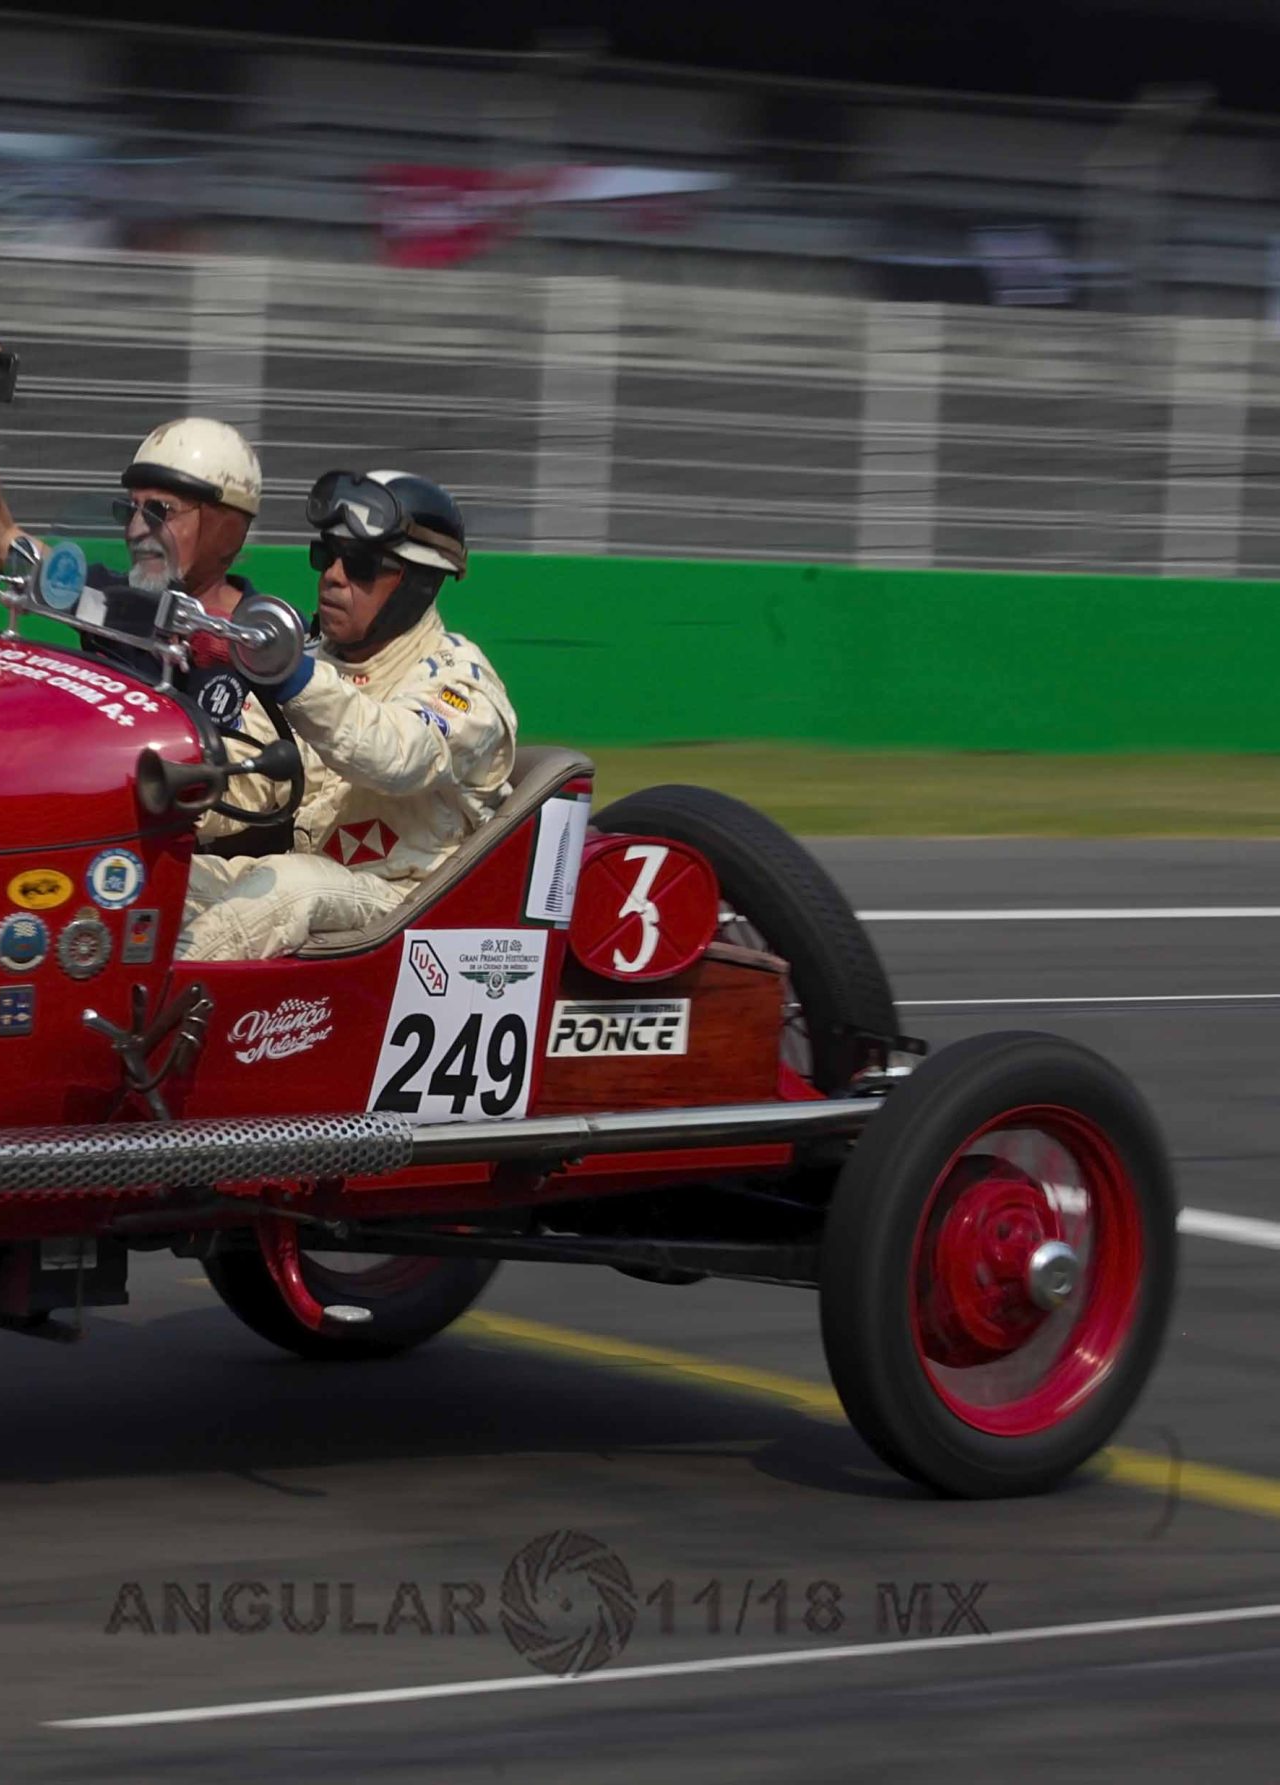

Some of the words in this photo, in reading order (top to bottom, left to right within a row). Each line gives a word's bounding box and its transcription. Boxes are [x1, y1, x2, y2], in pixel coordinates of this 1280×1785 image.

[26, 655, 127, 693] VIVANCO
[47, 677, 107, 703] OHM
[97, 703, 136, 727] A+
[613, 845, 669, 972] 3
[495, 940, 508, 953] XII
[415, 946, 444, 990] IUSA
[227, 1007, 333, 1044] Vivanco
[552, 1017, 680, 1052] PONCE
[373, 1013, 528, 1116] 249
